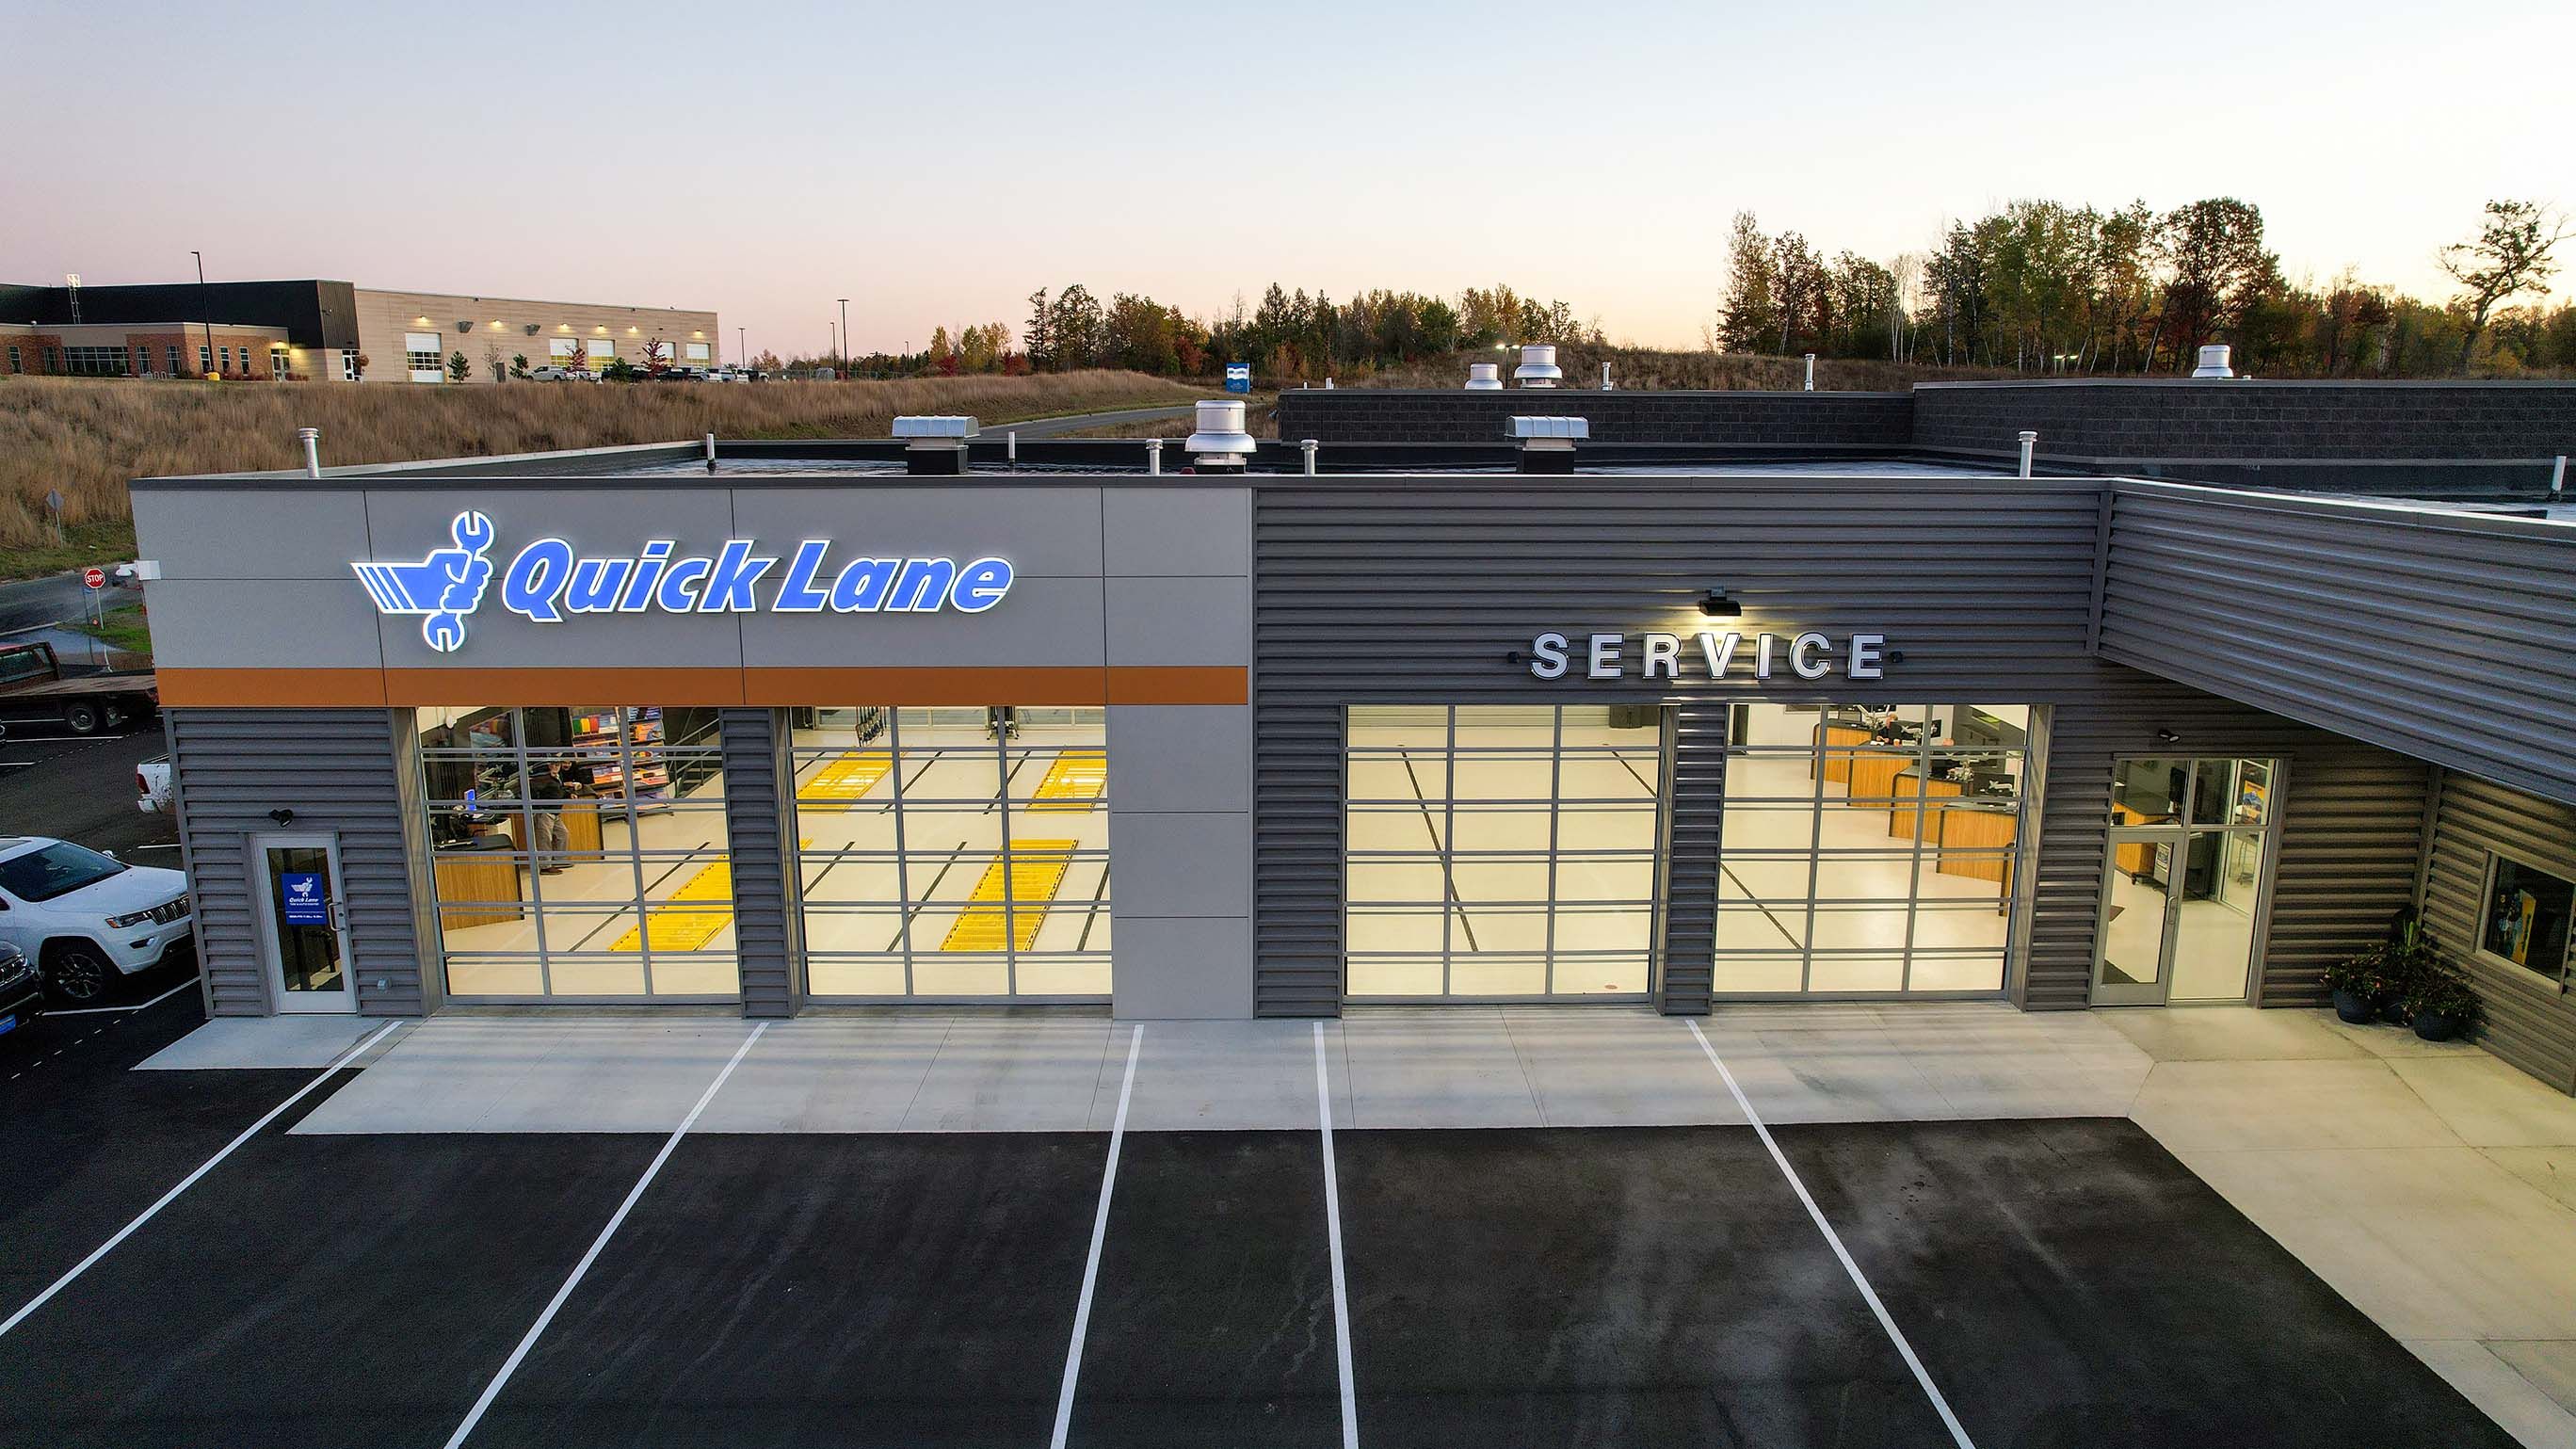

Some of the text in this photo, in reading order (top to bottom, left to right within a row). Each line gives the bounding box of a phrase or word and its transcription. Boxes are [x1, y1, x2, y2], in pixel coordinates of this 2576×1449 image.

[87, 574, 104, 583] STOP
[501, 538, 1015, 623] Quick Lane
[1531, 631, 1886, 680] SERVICE
